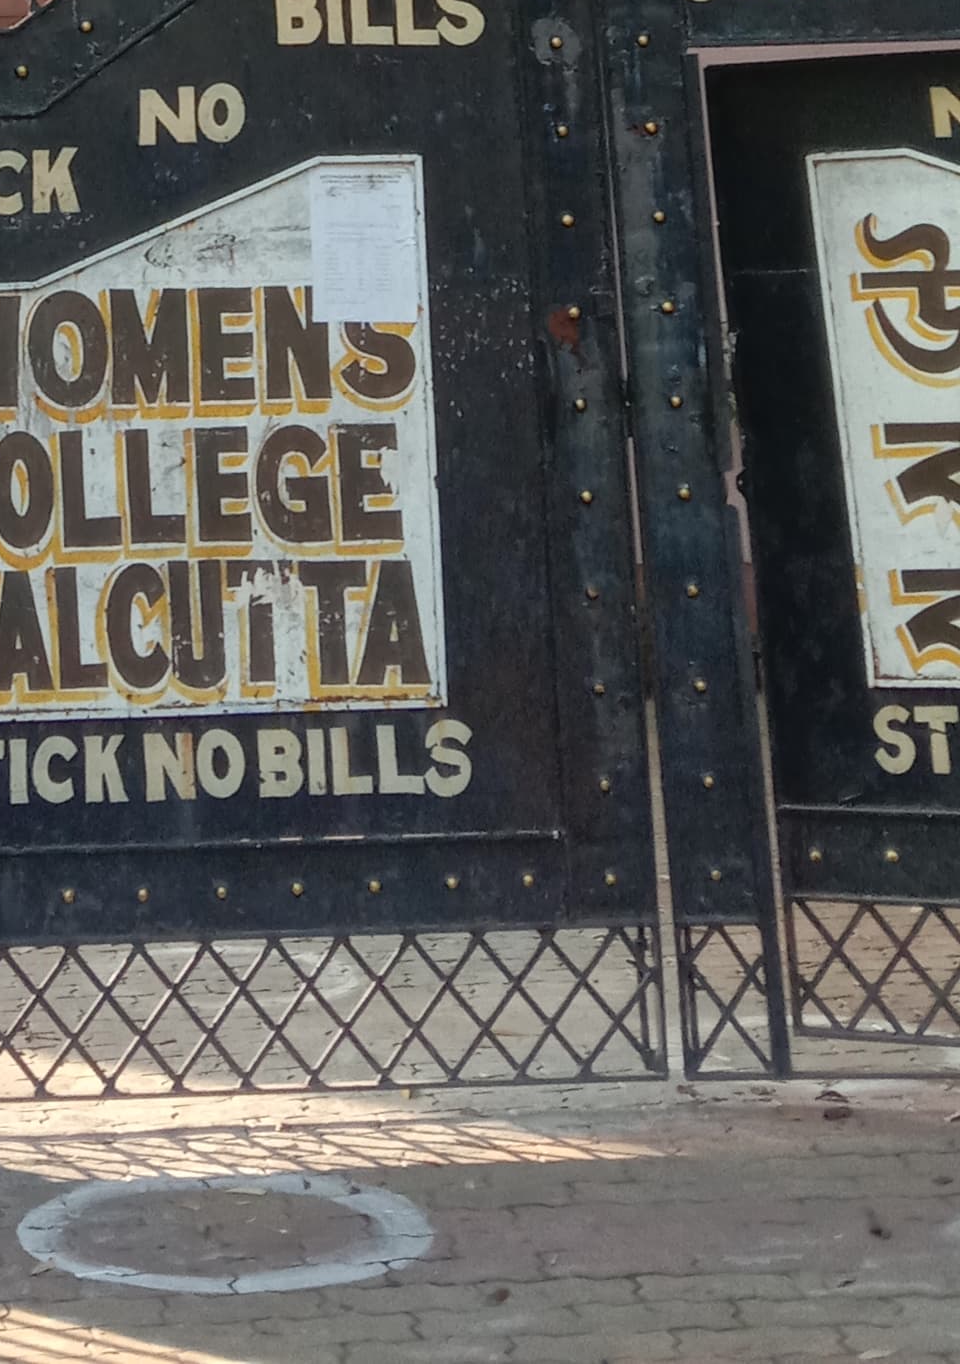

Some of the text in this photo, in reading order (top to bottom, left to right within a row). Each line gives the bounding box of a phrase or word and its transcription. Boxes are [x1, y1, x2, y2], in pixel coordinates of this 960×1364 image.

[137, 82, 246, 146] NO
[144, 728, 245, 802] NO
[255, 719, 473, 799] BILLS
[872, 704, 960, 775] ST
